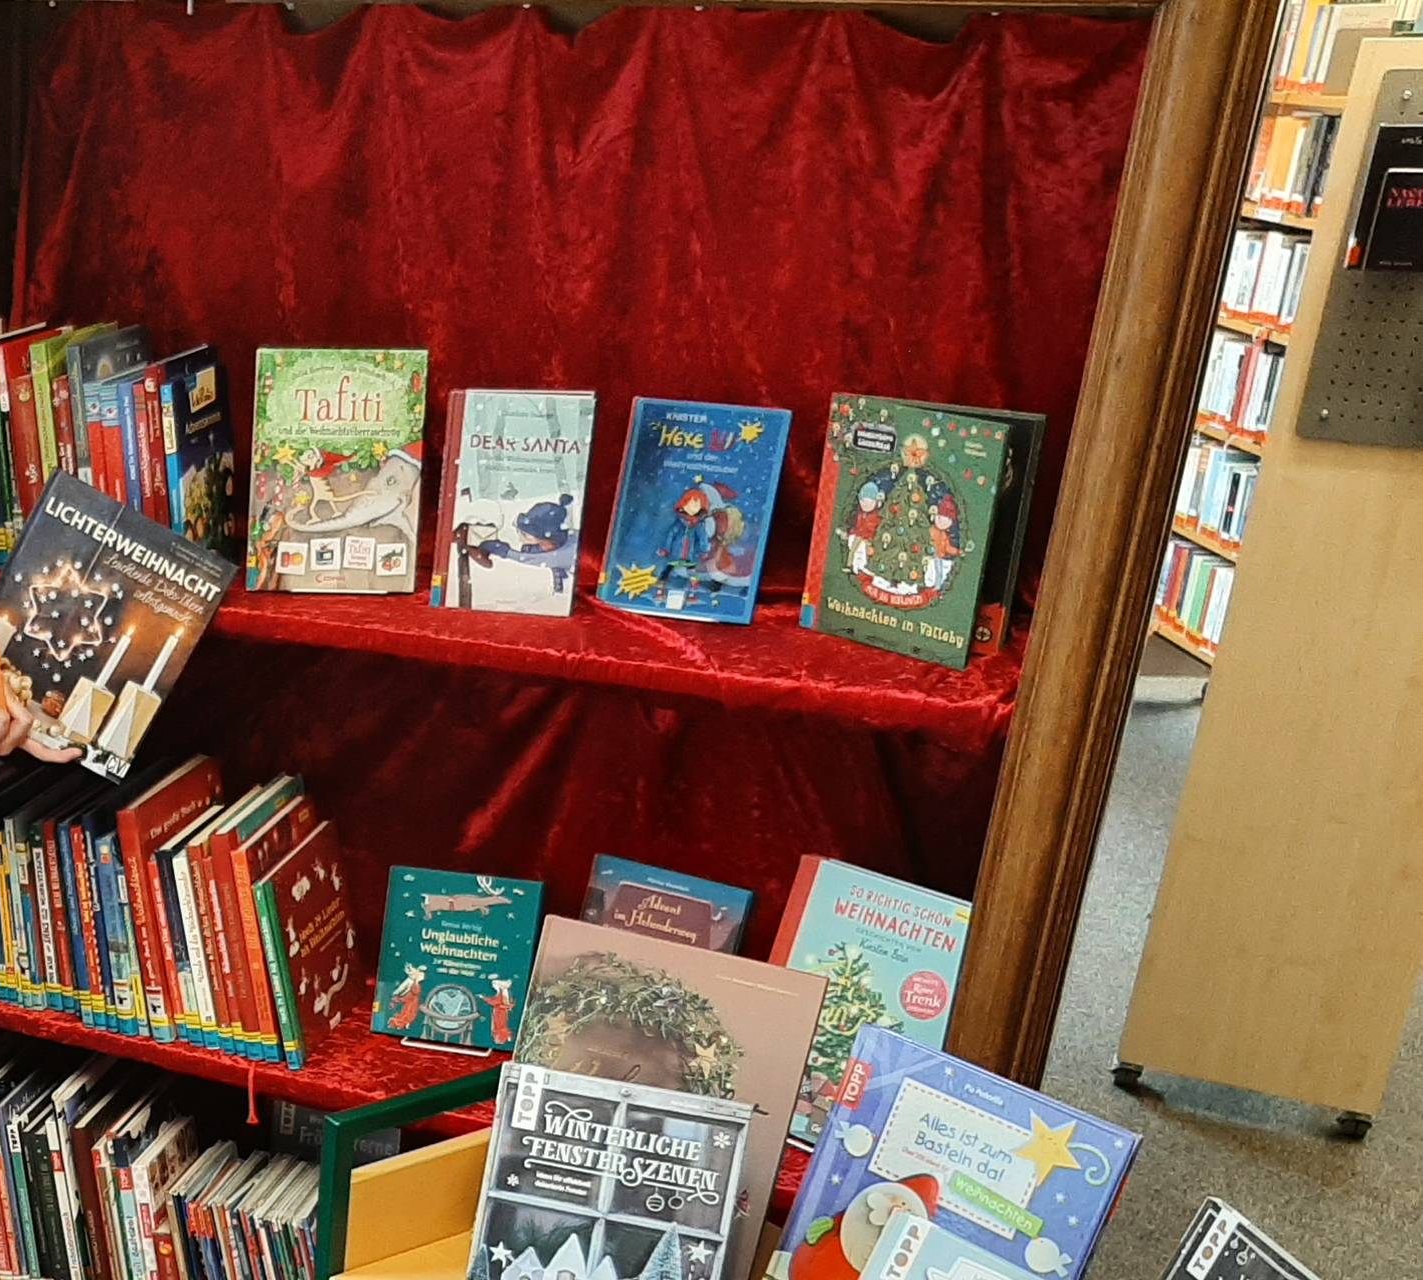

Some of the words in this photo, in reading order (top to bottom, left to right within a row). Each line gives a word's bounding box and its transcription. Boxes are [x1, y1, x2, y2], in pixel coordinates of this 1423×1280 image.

[295, 375, 383, 422] Tafiti
[470, 434, 516, 452] DEAR
[522, 437, 581, 455] SANTA
[44, 496, 221, 602] LICHTERWEIHNACHT
[827, 596, 898, 629] Weihnachten
[901, 619, 914, 633] in
[638, 894, 682, 916] Advent
[850, 884, 865, 899] SO
[866, 890, 912, 915] RICHTIG
[422, 928, 499, 948] Unglaubliche
[834, 897, 958, 953] WEIHNACHTEN
[420, 942, 498, 962] Weihnachten
[905, 989, 942, 1008] Trenk
[518, 1072, 538, 1123] TOPP
[844, 1063, 866, 1103] TOPP
[9, 1127, 19, 1149] TOPP
[543, 1105, 702, 1162] WINTERLICHE
[919, 1112, 957, 1139] Alles
[959, 1129, 980, 1148] ist
[981, 1142, 1013, 1165] zum
[914, 1131, 972, 1168] Basteln
[977, 1159, 1006, 1183] da!
[117, 1168, 129, 1188] TOPP
[886, 1225, 920, 1278] TOPP
[1193, 1219, 1227, 1271] TOPP
